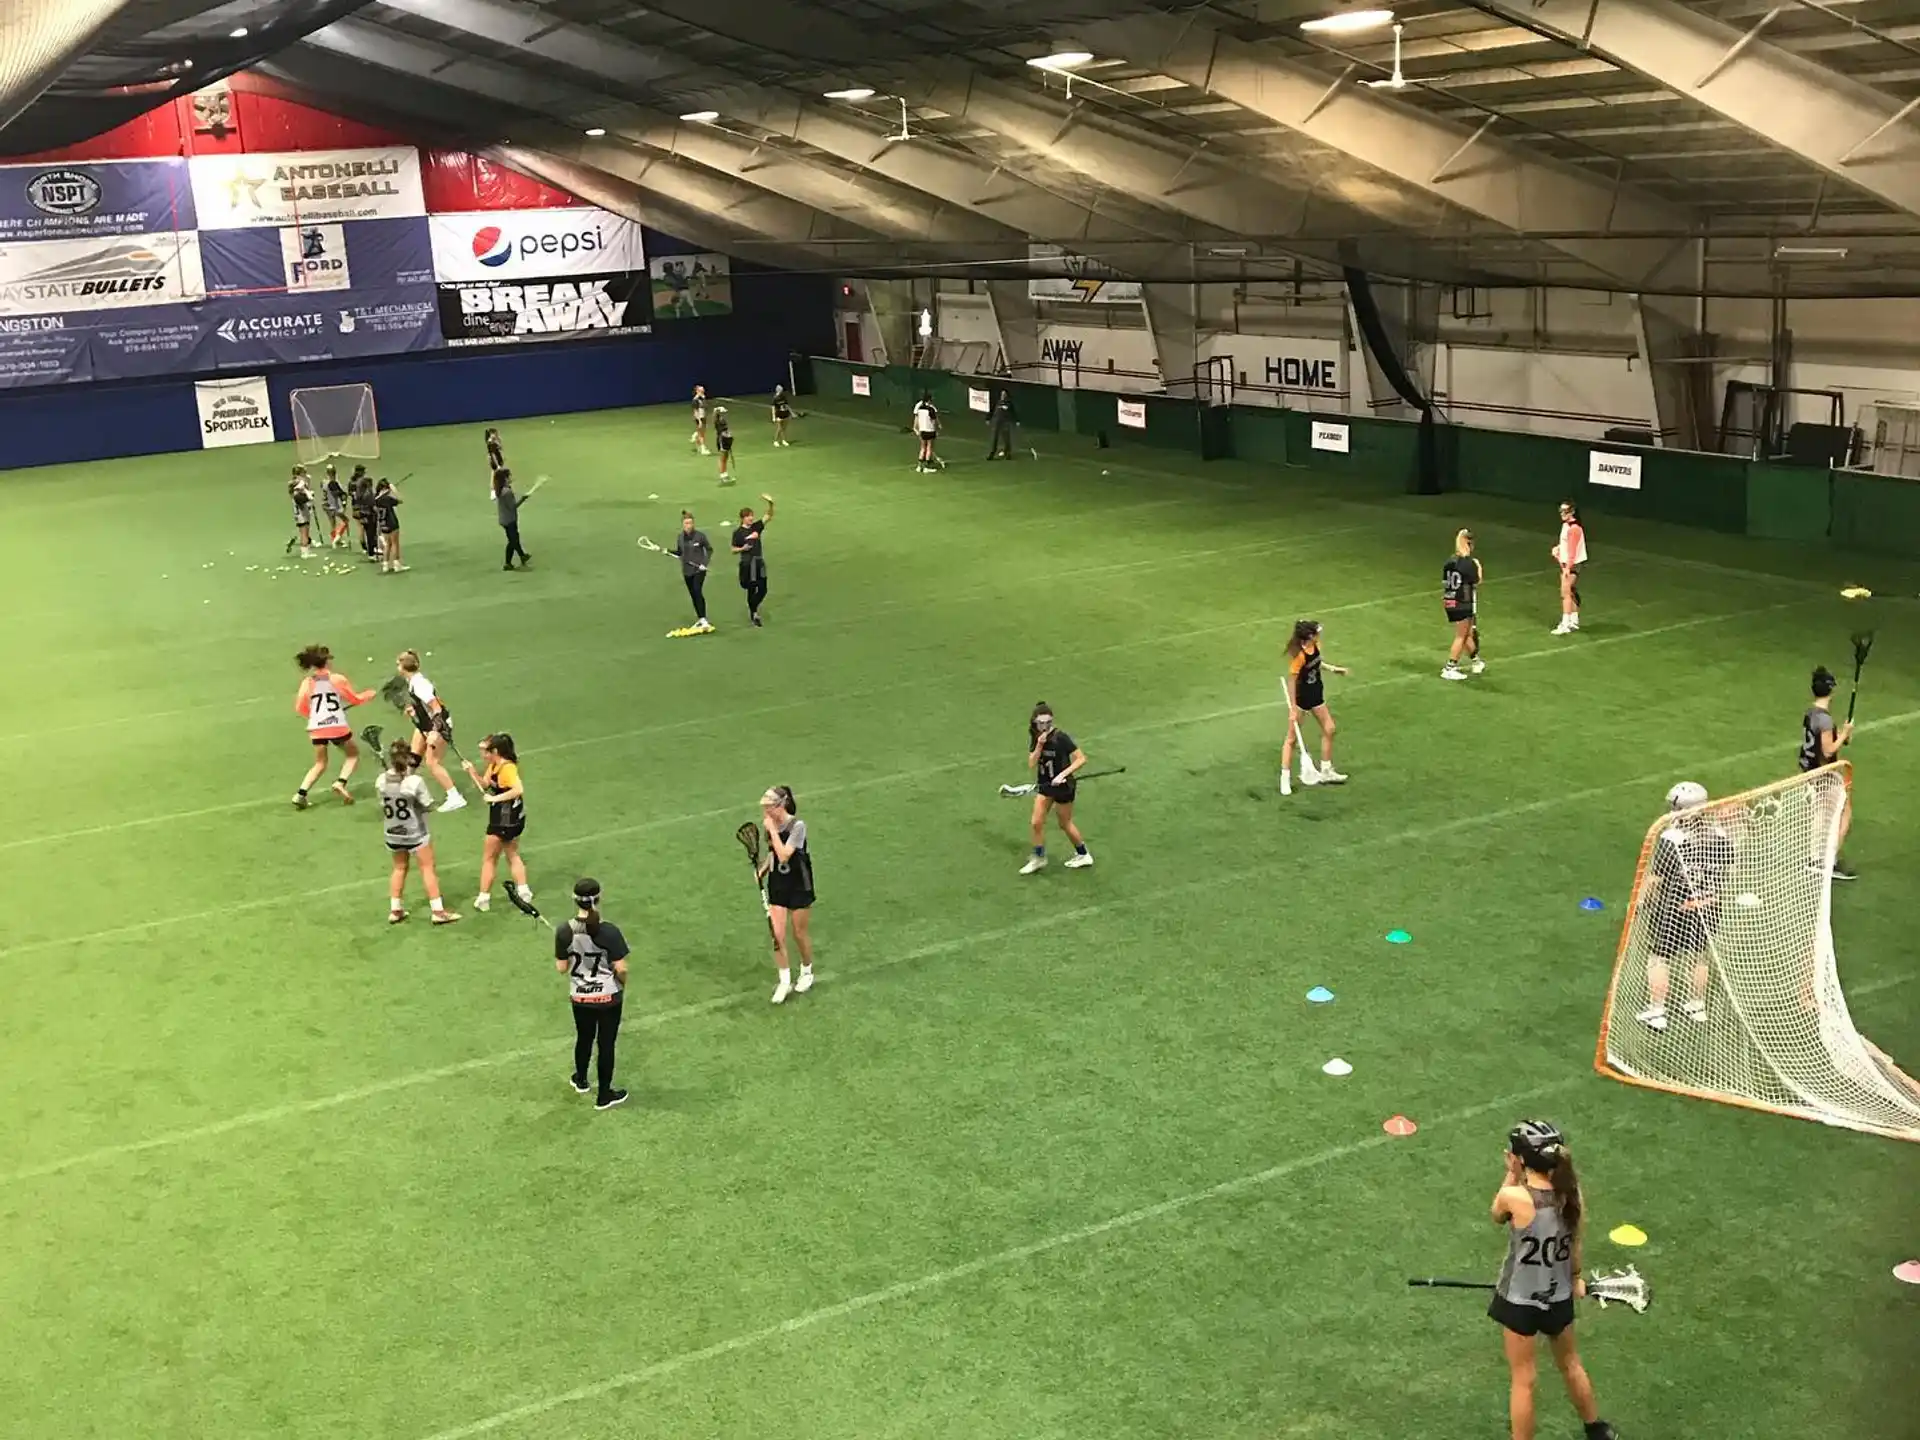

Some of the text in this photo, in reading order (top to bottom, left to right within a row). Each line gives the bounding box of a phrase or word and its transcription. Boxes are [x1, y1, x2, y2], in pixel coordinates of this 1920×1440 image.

[273, 159, 399, 181] ANTONELLI
[41, 184, 86, 202] NSPT
[280, 181, 400, 201] BASEBALL
[520, 225, 602, 261] pepsi
[291, 258, 343, 284] FORD
[460, 280, 611, 314] BREAK
[238, 313, 323, 332] ACCURATE
[463, 313, 490, 327] dine
[513, 296, 628, 334] AWAY
[239, 328, 298, 341] GRAPHICS
[1041, 338, 1084, 364] AWAY
[1265, 356, 1336, 389] HOME
[310, 692, 340, 713] 75
[568, 950, 603, 979] 27
